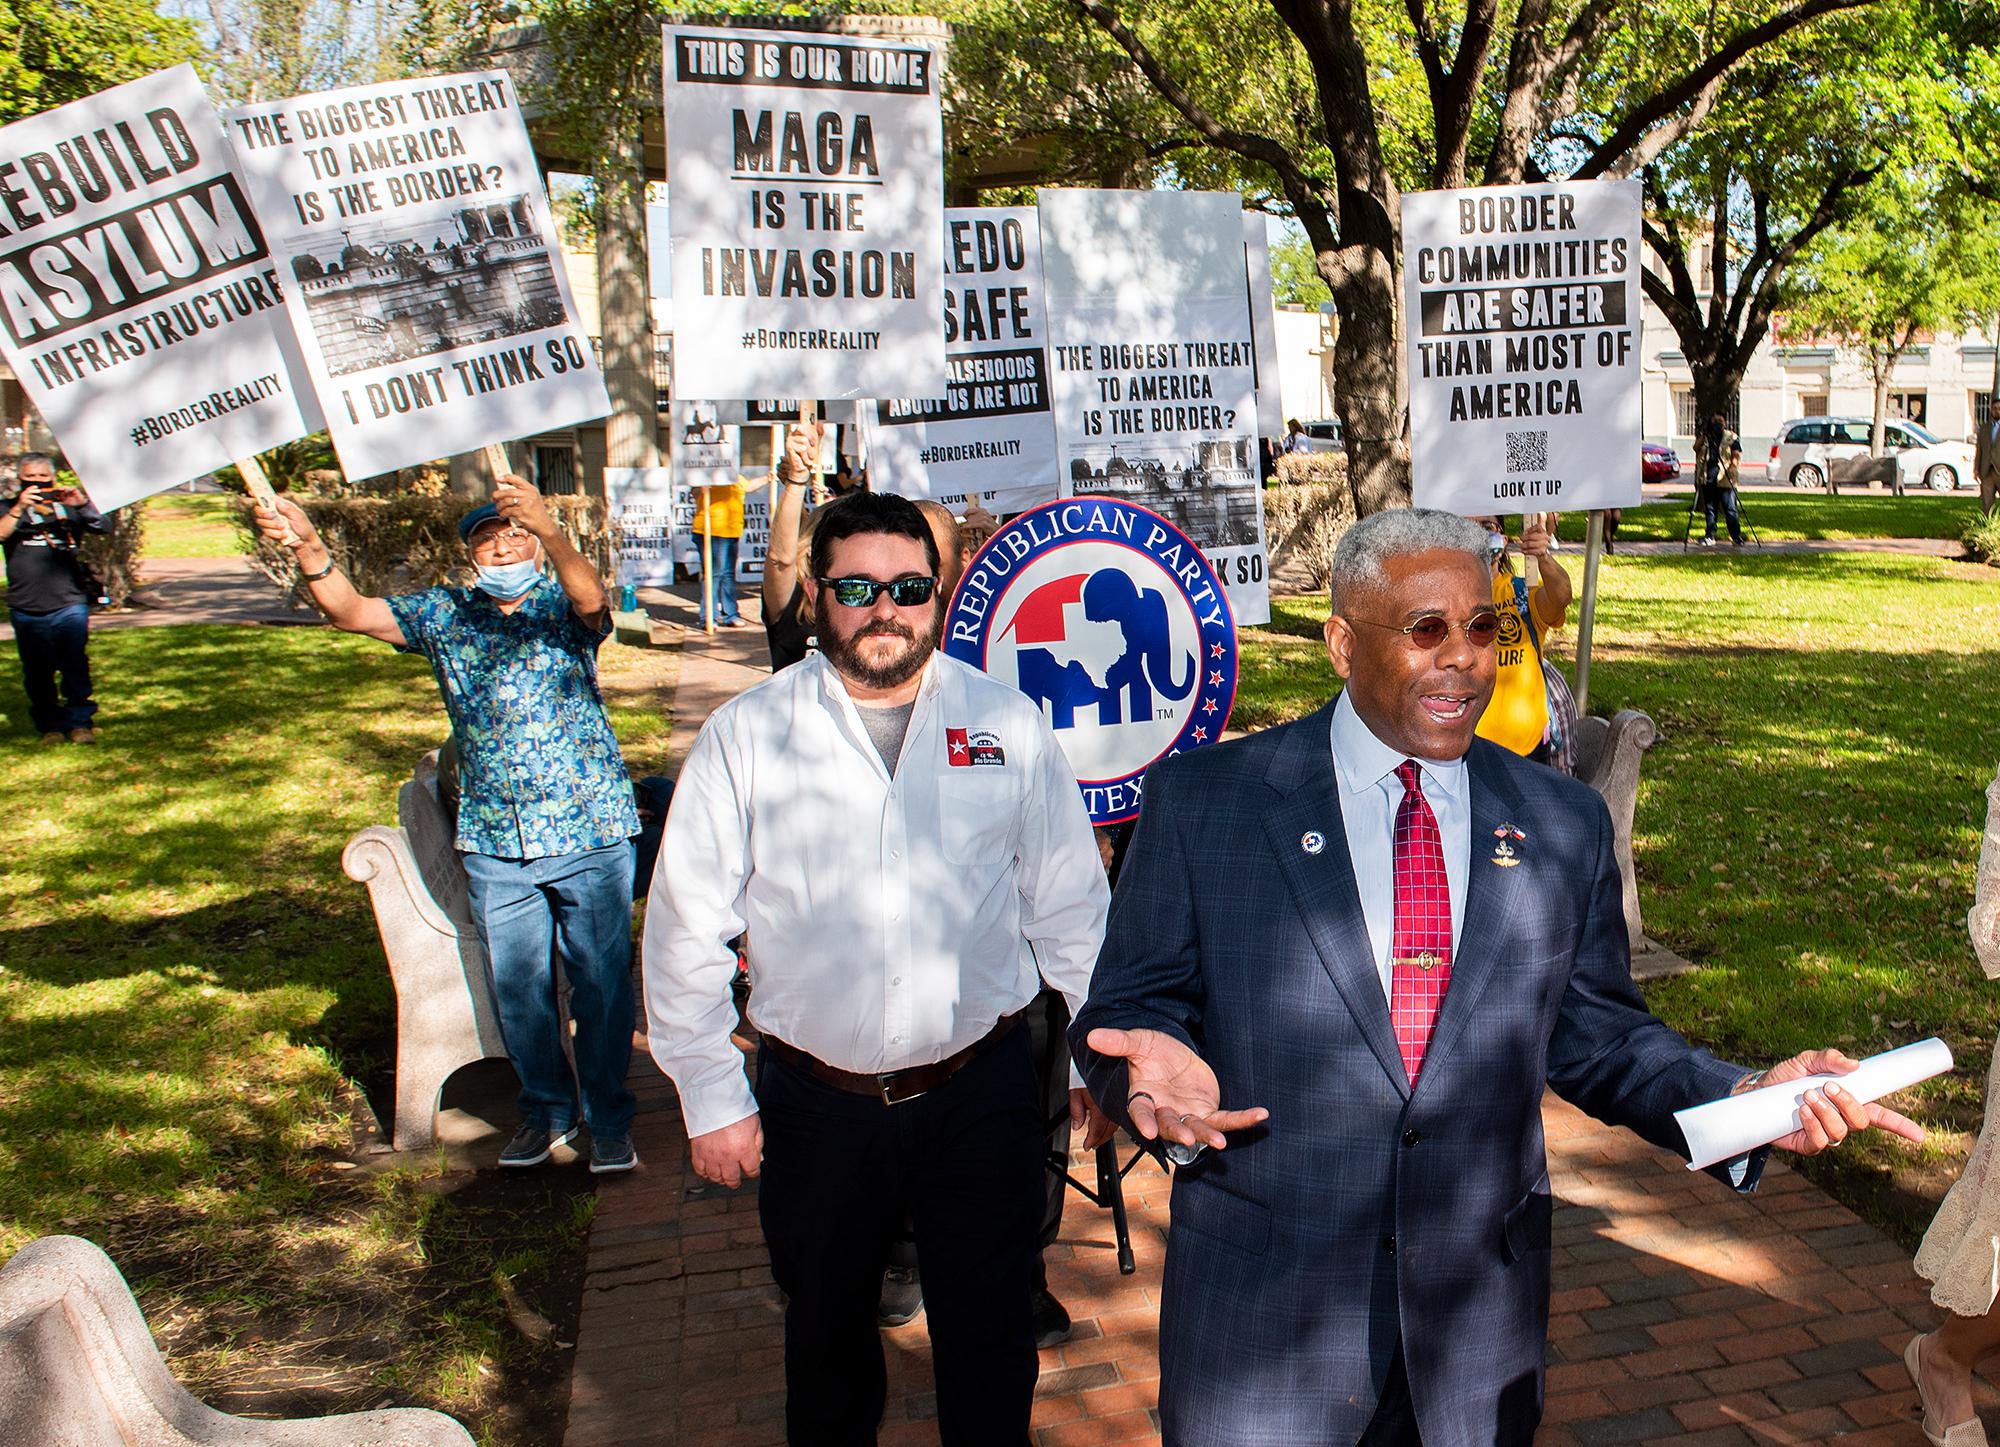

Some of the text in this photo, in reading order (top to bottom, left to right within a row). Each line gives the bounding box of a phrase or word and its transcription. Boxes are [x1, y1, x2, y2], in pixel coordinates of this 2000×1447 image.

[684, 40, 923, 87] THIS IS OUR HOME
[235, 79, 508, 150] THE BIGGEST THREAT
[303, 126, 467, 181] TO AMERICA
[732, 108, 880, 176] MAGA
[0, 107, 200, 239] EBUILD
[293, 162, 504, 225] IS THE BORDER?
[751, 189, 865, 231] IS THE
[1459, 193, 1577, 235] BORDER
[0, 182, 258, 339] ASYLUM
[701, 247, 916, 300] INVASION
[1418, 237, 1627, 284] COMMUNITIES
[31, 268, 285, 390] INFRASTRUCTURE
[945, 287, 1032, 343] SAFE
[1442, 285, 1605, 333] ARE SAFER
[947, 355, 1036, 384] ALSEHOODS
[1056, 342, 1250, 371] THE BIGGEST THREAT
[1418, 330, 1632, 378] THAN MOST OF
[342, 335, 585, 425] I DONT THINK SO
[947, 388, 969, 411] US
[974, 385, 1005, 410] ARE
[1009, 382, 1039, 407] NOT
[1097, 374, 1213, 403] TO AMERICA
[1450, 379, 1583, 422] AMERICA
[1083, 405, 1236, 436] IS THE BORDER?
[1494, 480, 1562, 499] LOOK IT UP
[952, 505, 1225, 645] REPUBLICAN PARTY
[1237, 553, 1262, 585] SO
[1156, 708, 1174, 719] TM
